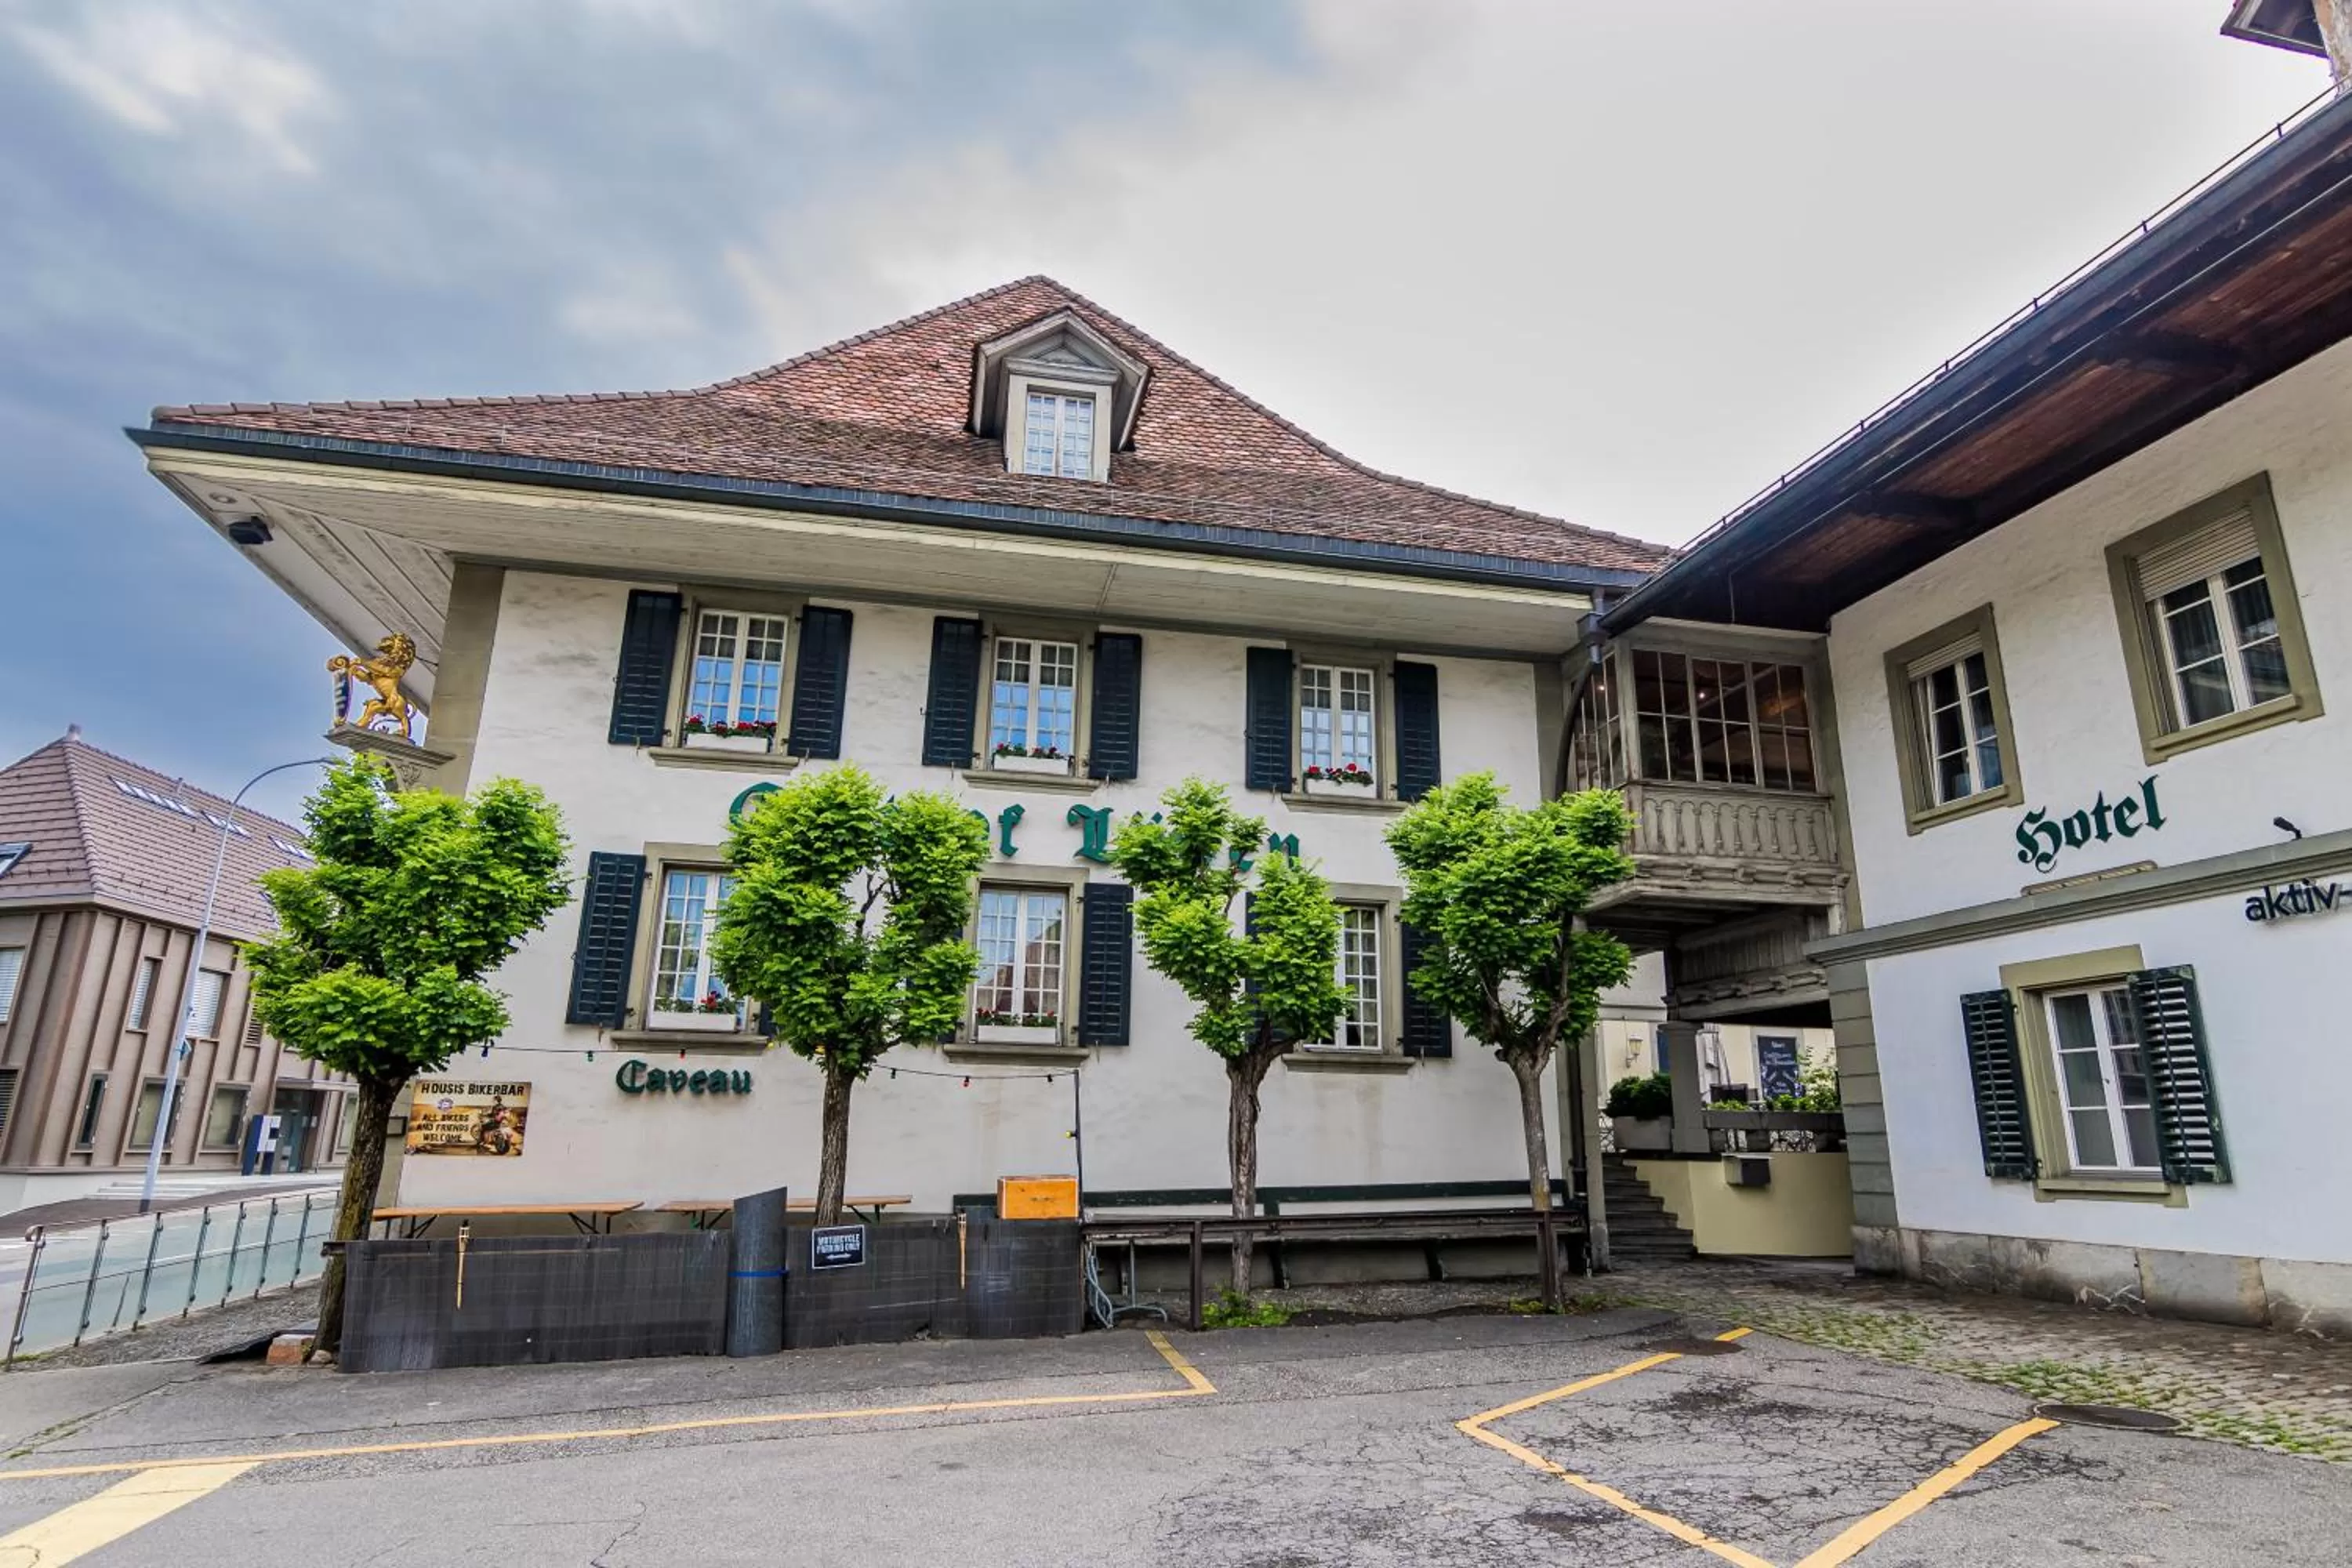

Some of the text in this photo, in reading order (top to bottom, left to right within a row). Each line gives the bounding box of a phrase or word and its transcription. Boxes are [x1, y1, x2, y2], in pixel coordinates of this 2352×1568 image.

[2016, 774, 2167, 873] Hotel
[421, 1083, 524, 1096] HOUSIS BIKERBAR
[615, 1059, 753, 1094] Caveau
